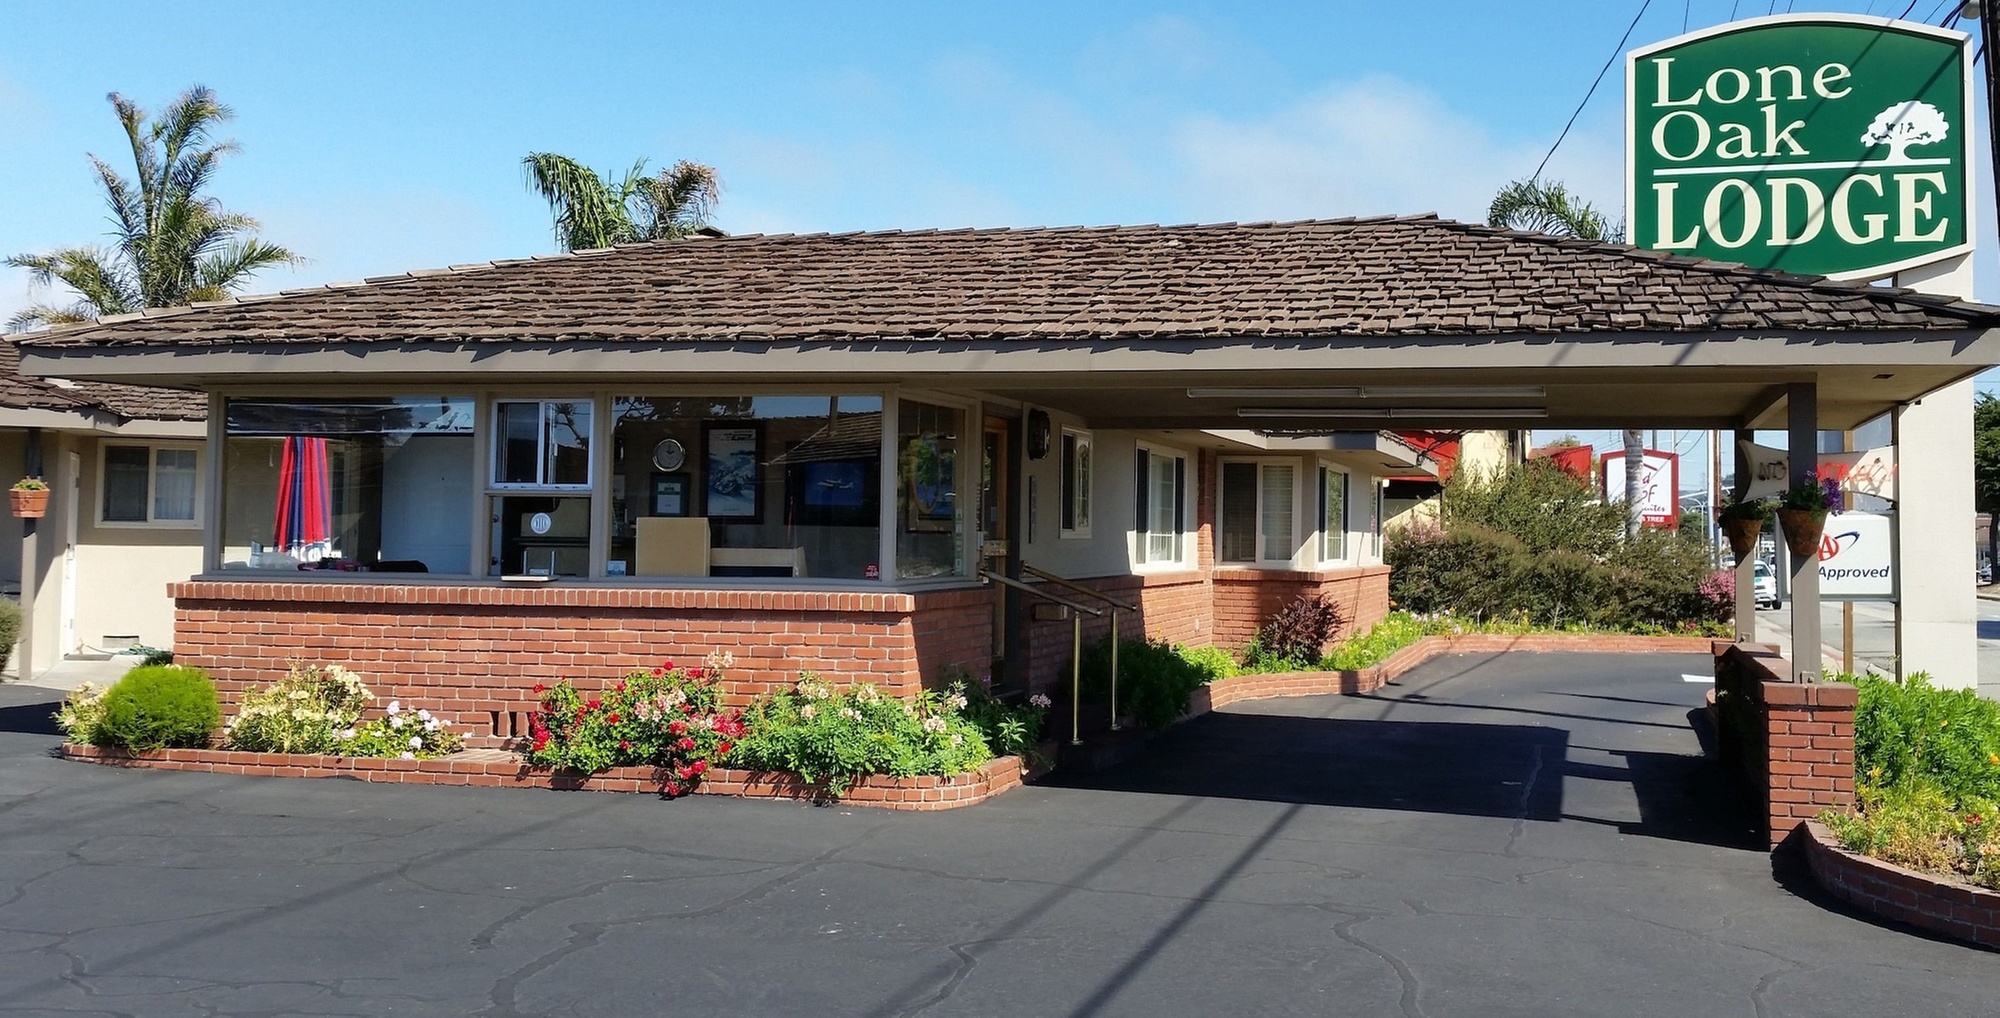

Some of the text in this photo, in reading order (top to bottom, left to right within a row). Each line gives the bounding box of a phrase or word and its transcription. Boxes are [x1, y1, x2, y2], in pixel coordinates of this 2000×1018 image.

[1652, 58, 1852, 107] Lone
[1651, 104, 1810, 162] Oak
[1652, 171, 1949, 250] LODGE
[1819, 565, 1890, 580] Approved
